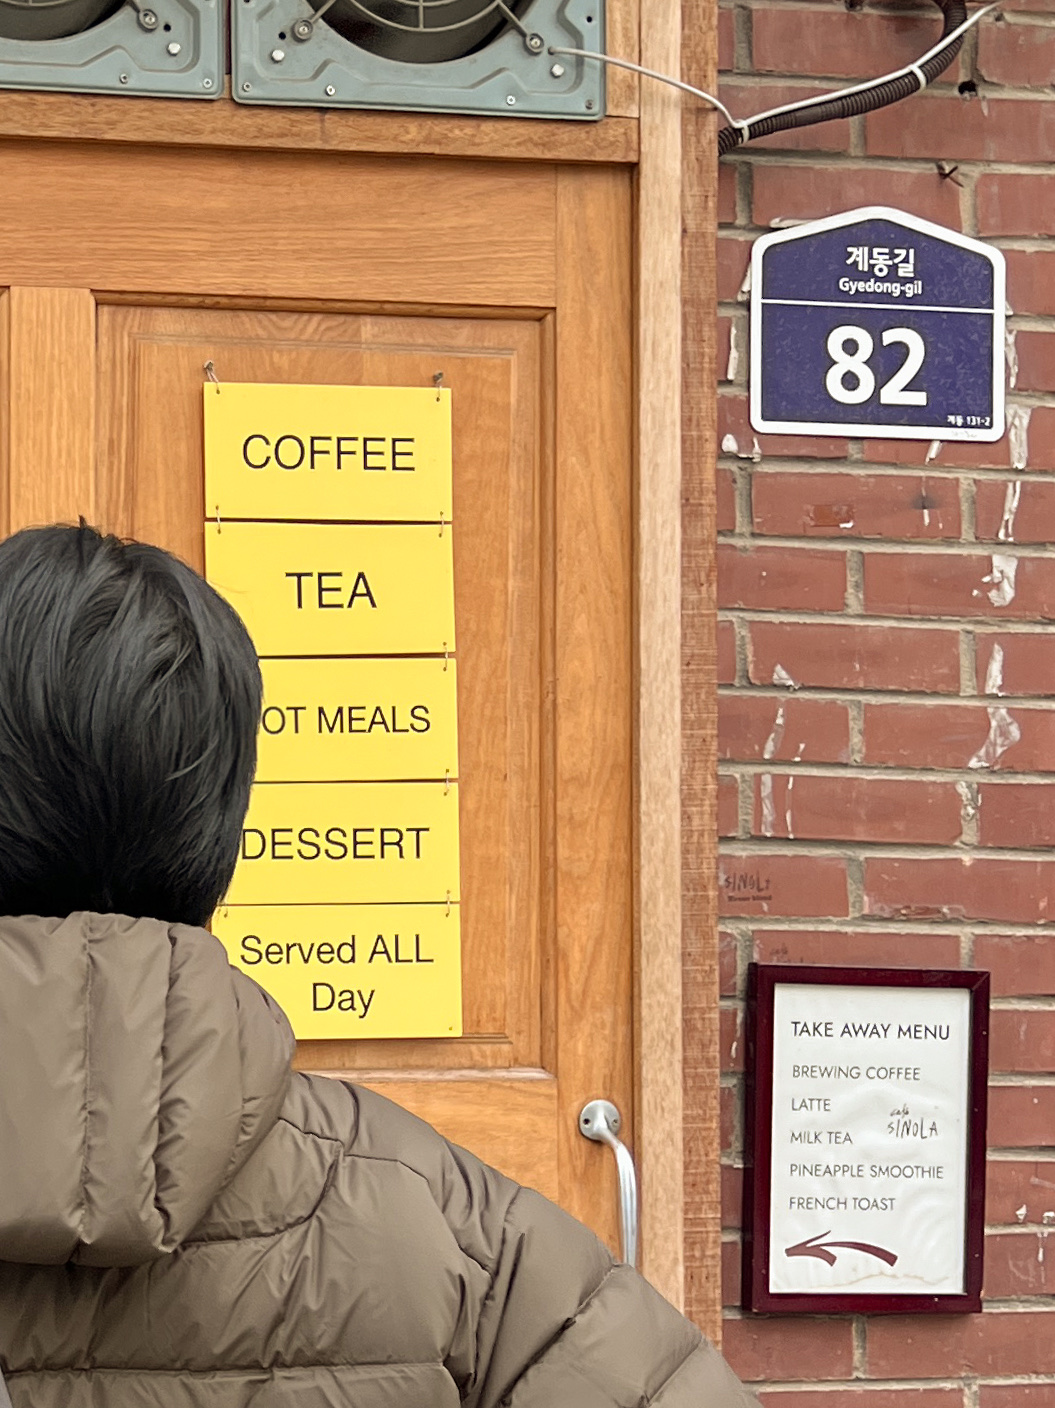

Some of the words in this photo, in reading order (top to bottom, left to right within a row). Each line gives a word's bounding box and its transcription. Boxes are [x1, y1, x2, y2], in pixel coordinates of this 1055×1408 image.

[846, 246, 914, 277] 계동길
[839, 277, 922, 298] Gyedong-gil
[825, 325, 927, 406] 82
[242, 434, 415, 471] COFFEE
[285, 571, 377, 609] TEA
[262, 706, 306, 734] OT
[318, 705, 431, 734] MEALS
[241, 827, 430, 860] DESSERT
[240, 935, 356, 965] Served
[368, 934, 434, 963] ALL
[312, 983, 375, 1018] Day
[791, 1021, 834, 1038] TAKE
[840, 1022, 891, 1039] AWAY
[897, 1024, 950, 1041] MENU
[792, 1065, 861, 1080] BREWING
[865, 1066, 921, 1081] COFFEE
[791, 1098, 831, 1112] LATTE
[790, 1131, 822, 1144] MILK
[827, 1131, 853, 1145] TEA
[887, 1117, 938, 1139] SINOLA
[790, 1164, 864, 1178] PINEAPPLE
[870, 1165, 944, 1179] SMOOTHIE
[789, 1197, 847, 1211] FRENCH
[853, 1198, 896, 1211] TOAST
